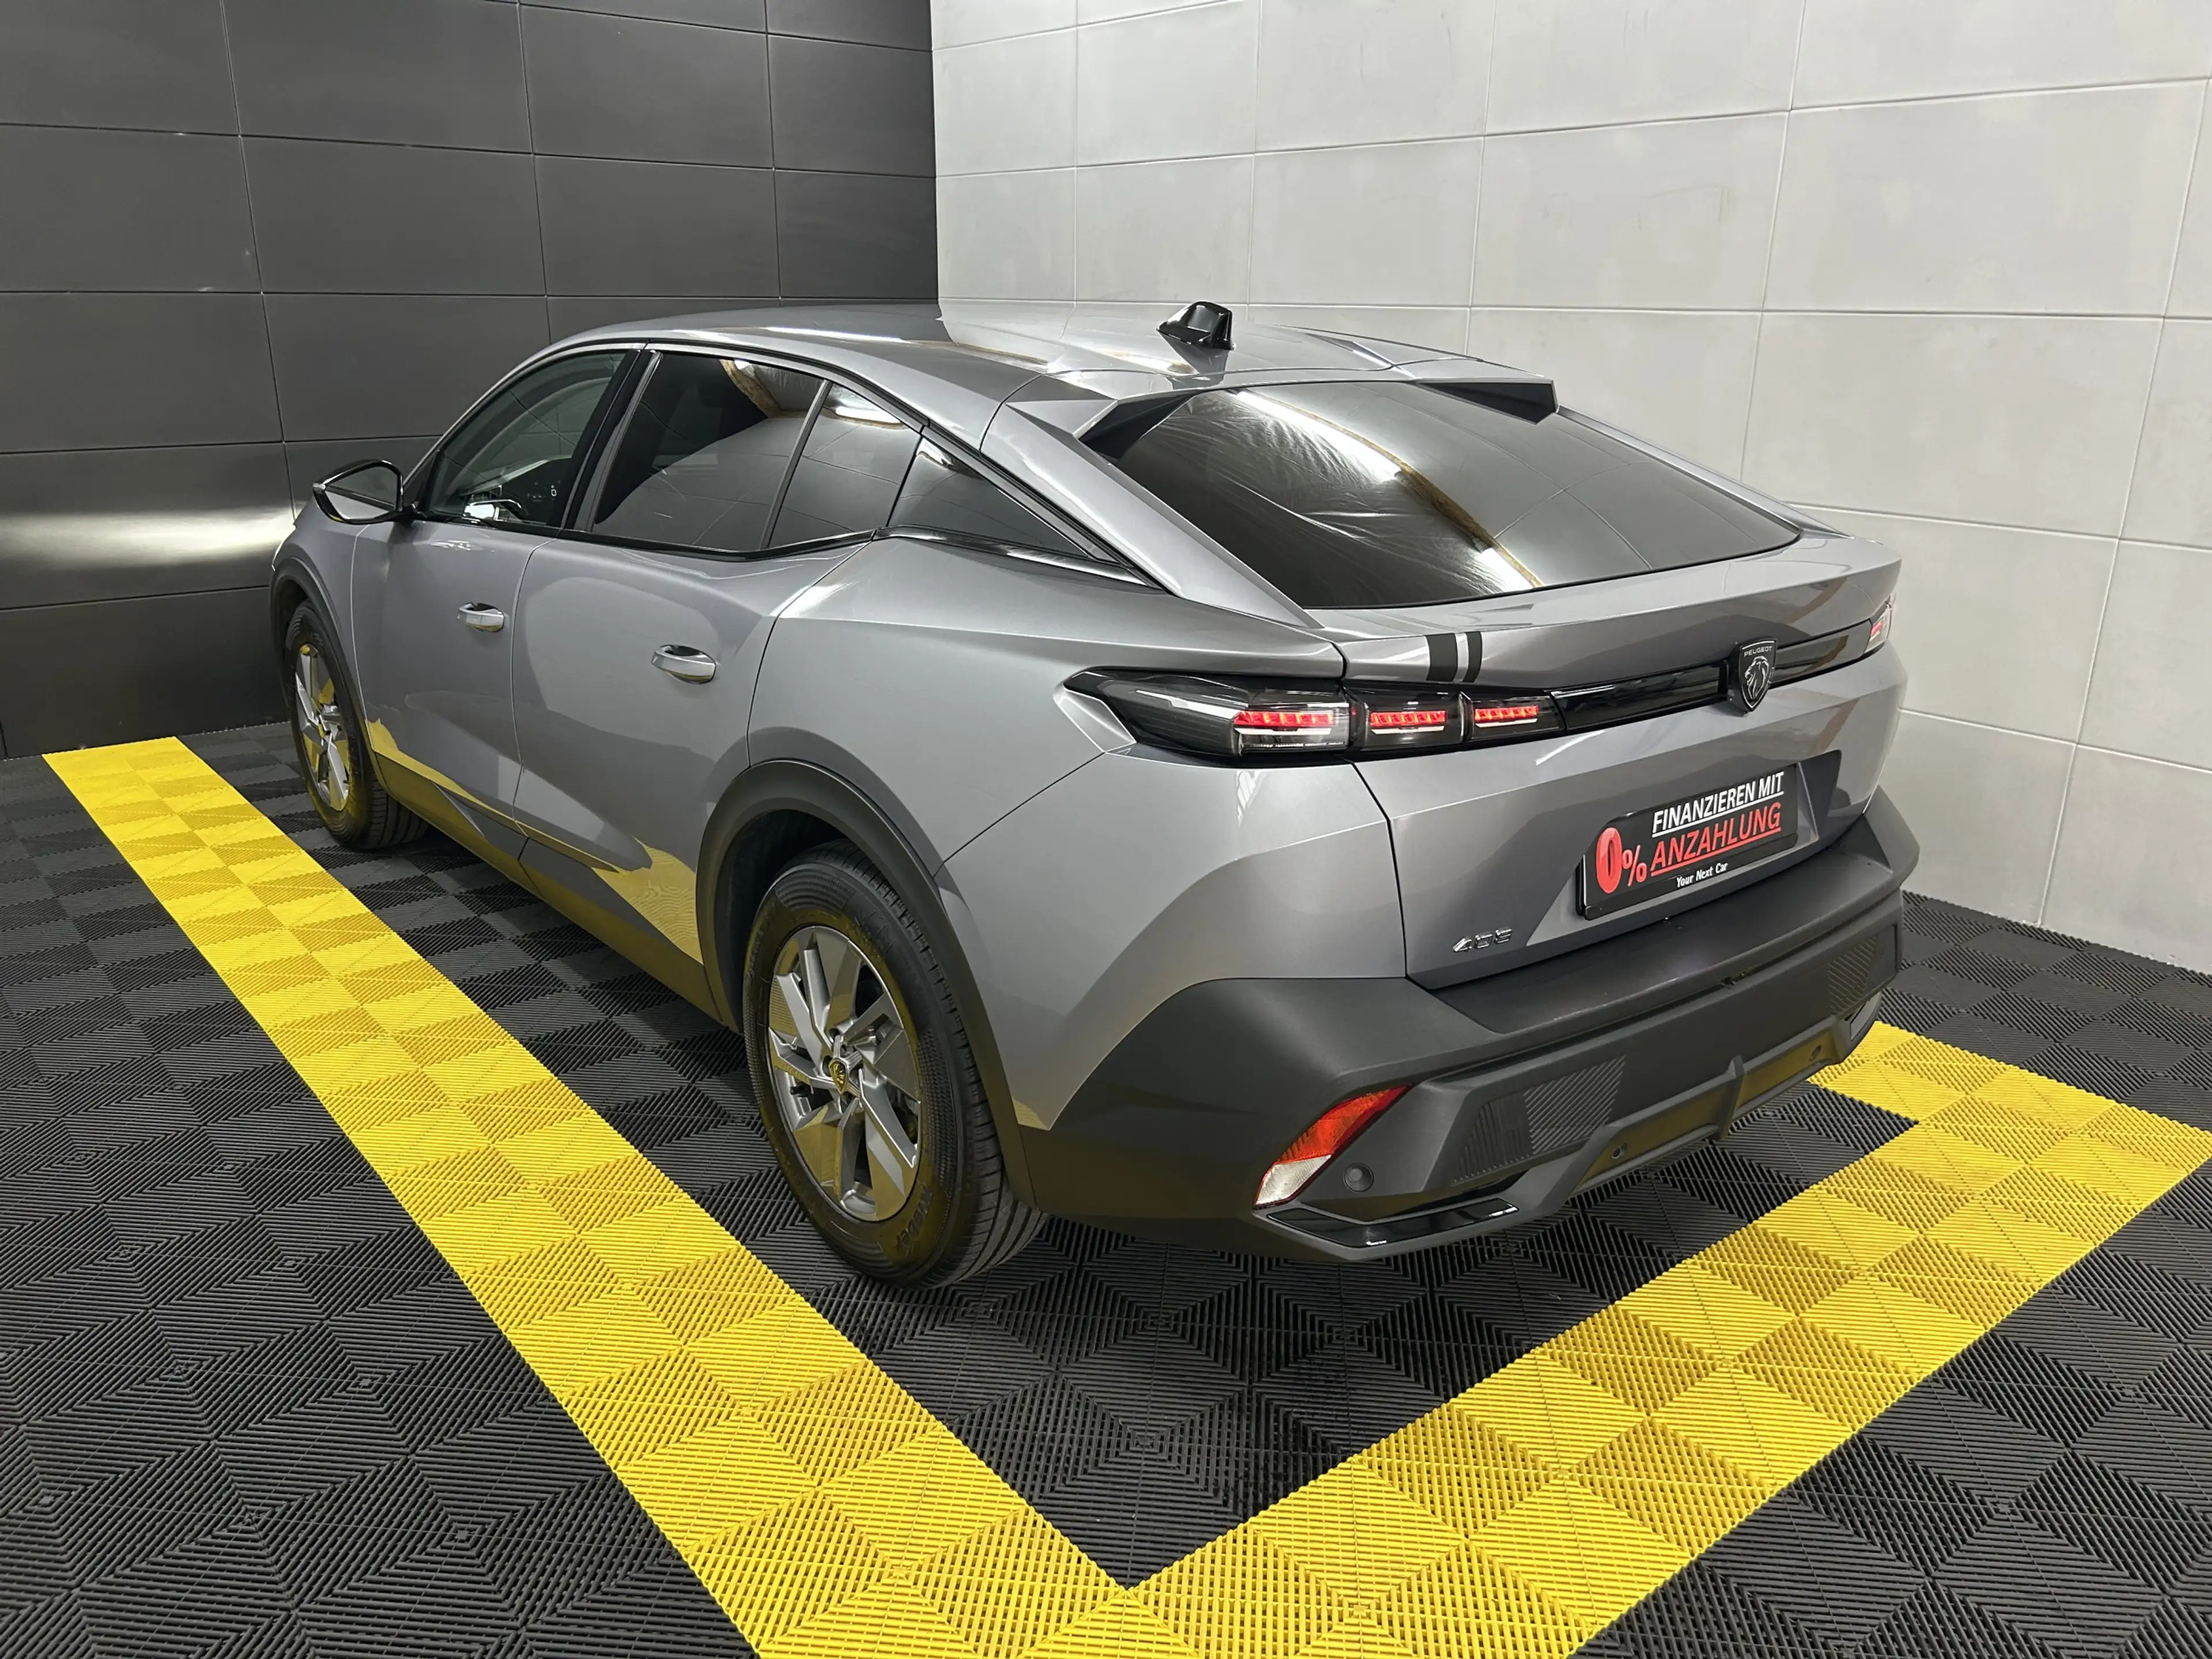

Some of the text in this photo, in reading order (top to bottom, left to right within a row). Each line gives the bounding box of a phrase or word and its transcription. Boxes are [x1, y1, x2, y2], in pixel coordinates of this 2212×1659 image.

[1744, 646, 1772, 657] PEUGEOT
[1652, 771, 1784, 834] FINANZIEREN MIT
[1596, 802, 1782, 893] 0% ANZAHLUNG
[1676, 862, 1728, 888] Your Next Car
